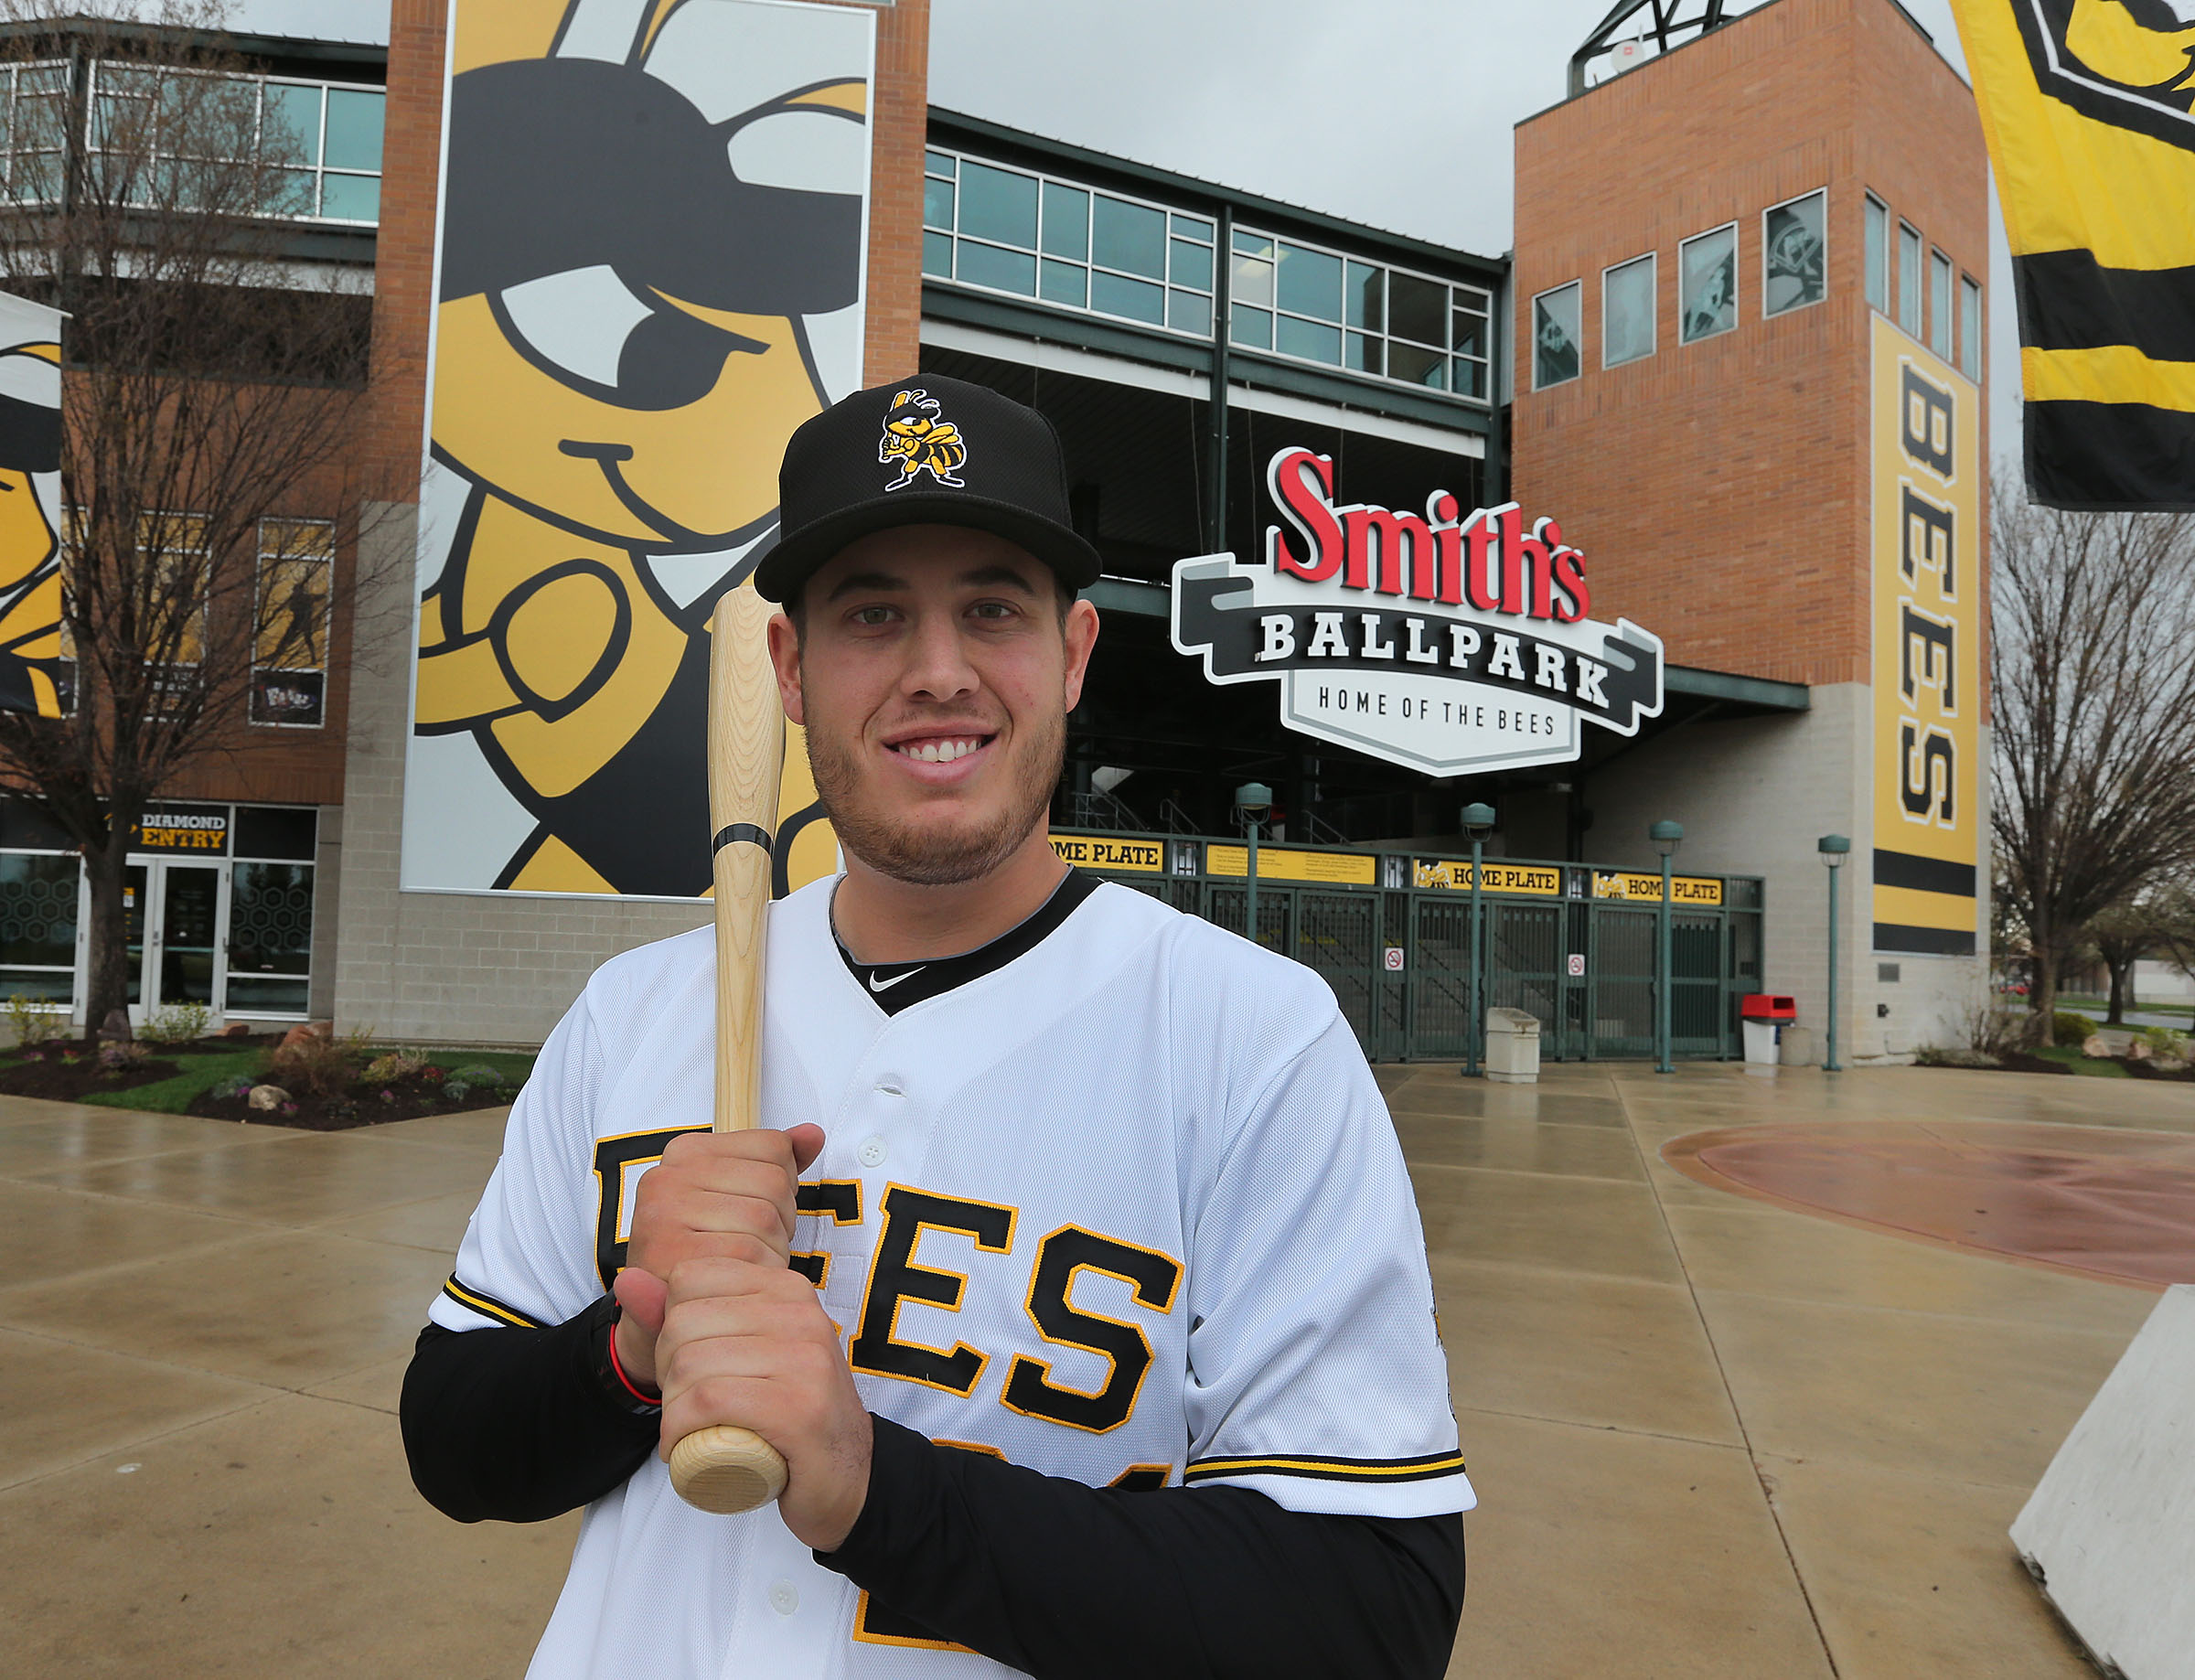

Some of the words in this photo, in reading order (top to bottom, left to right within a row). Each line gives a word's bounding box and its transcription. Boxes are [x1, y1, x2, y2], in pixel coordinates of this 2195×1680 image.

[1274, 451, 1590, 624] Smith's
[1897, 353, 1958, 832] BEES
[1259, 611, 1610, 710] BALLPARK
[1319, 686, 1387, 716] HOME
[1402, 697, 1429, 720] OF
[1443, 701, 1484, 727] THE
[1498, 709, 1553, 736] BEES
[141, 813, 226, 829] DIAMOND
[140, 827, 226, 849] ENTRY
[1092, 843, 1159, 866] PLATE
[1505, 871, 1555, 890] PLATE
[1628, 879, 1664, 897] HOM
[1674, 882, 1718, 900] PLATE
